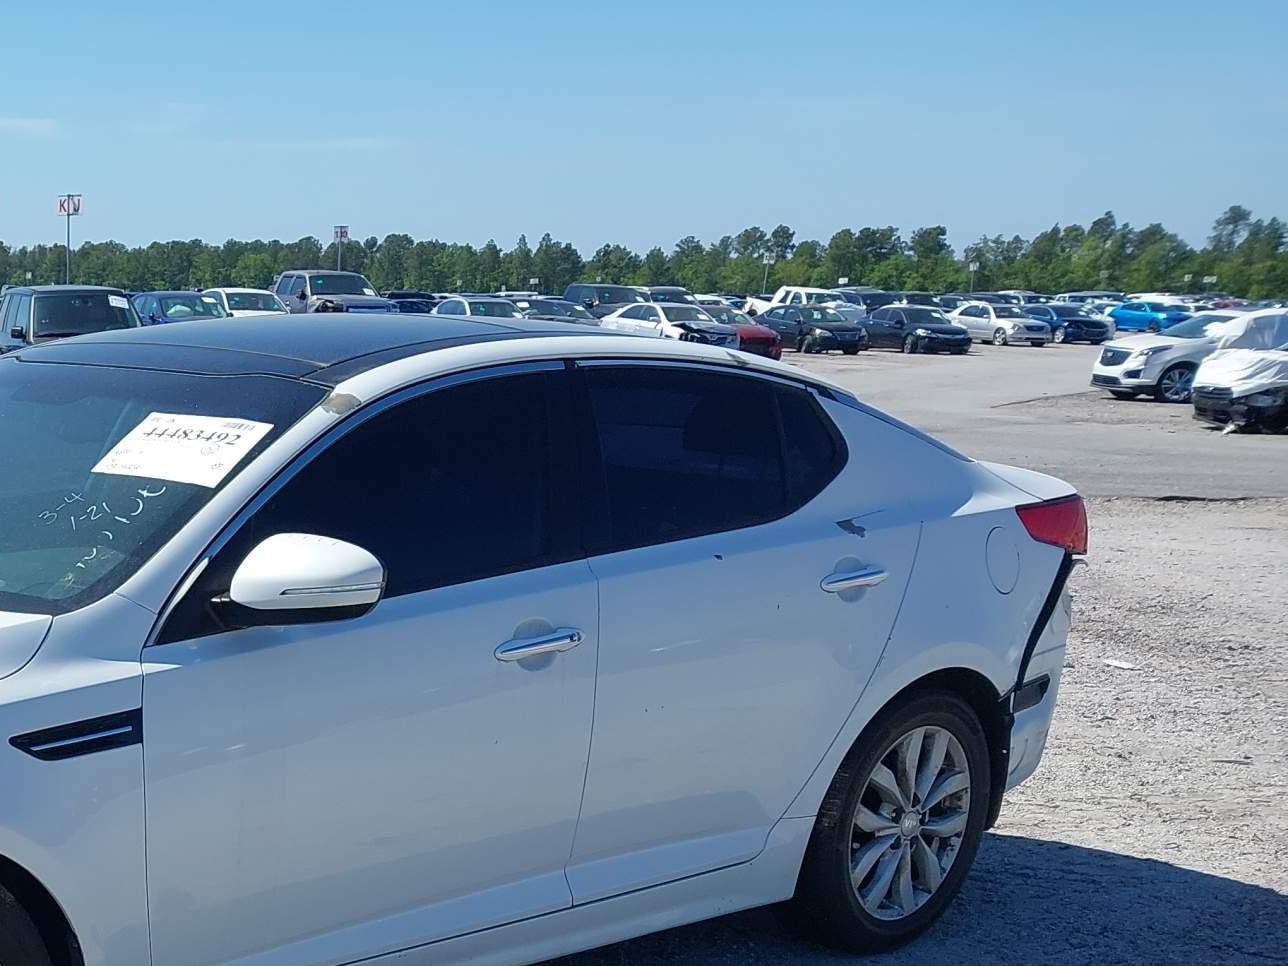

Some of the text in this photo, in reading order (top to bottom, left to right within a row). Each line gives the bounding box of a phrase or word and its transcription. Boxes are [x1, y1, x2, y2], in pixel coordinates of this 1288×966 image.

[59, 199, 68, 213] K
[143, 427, 243, 445] 44483492
[38, 492, 85, 525] 3-4
